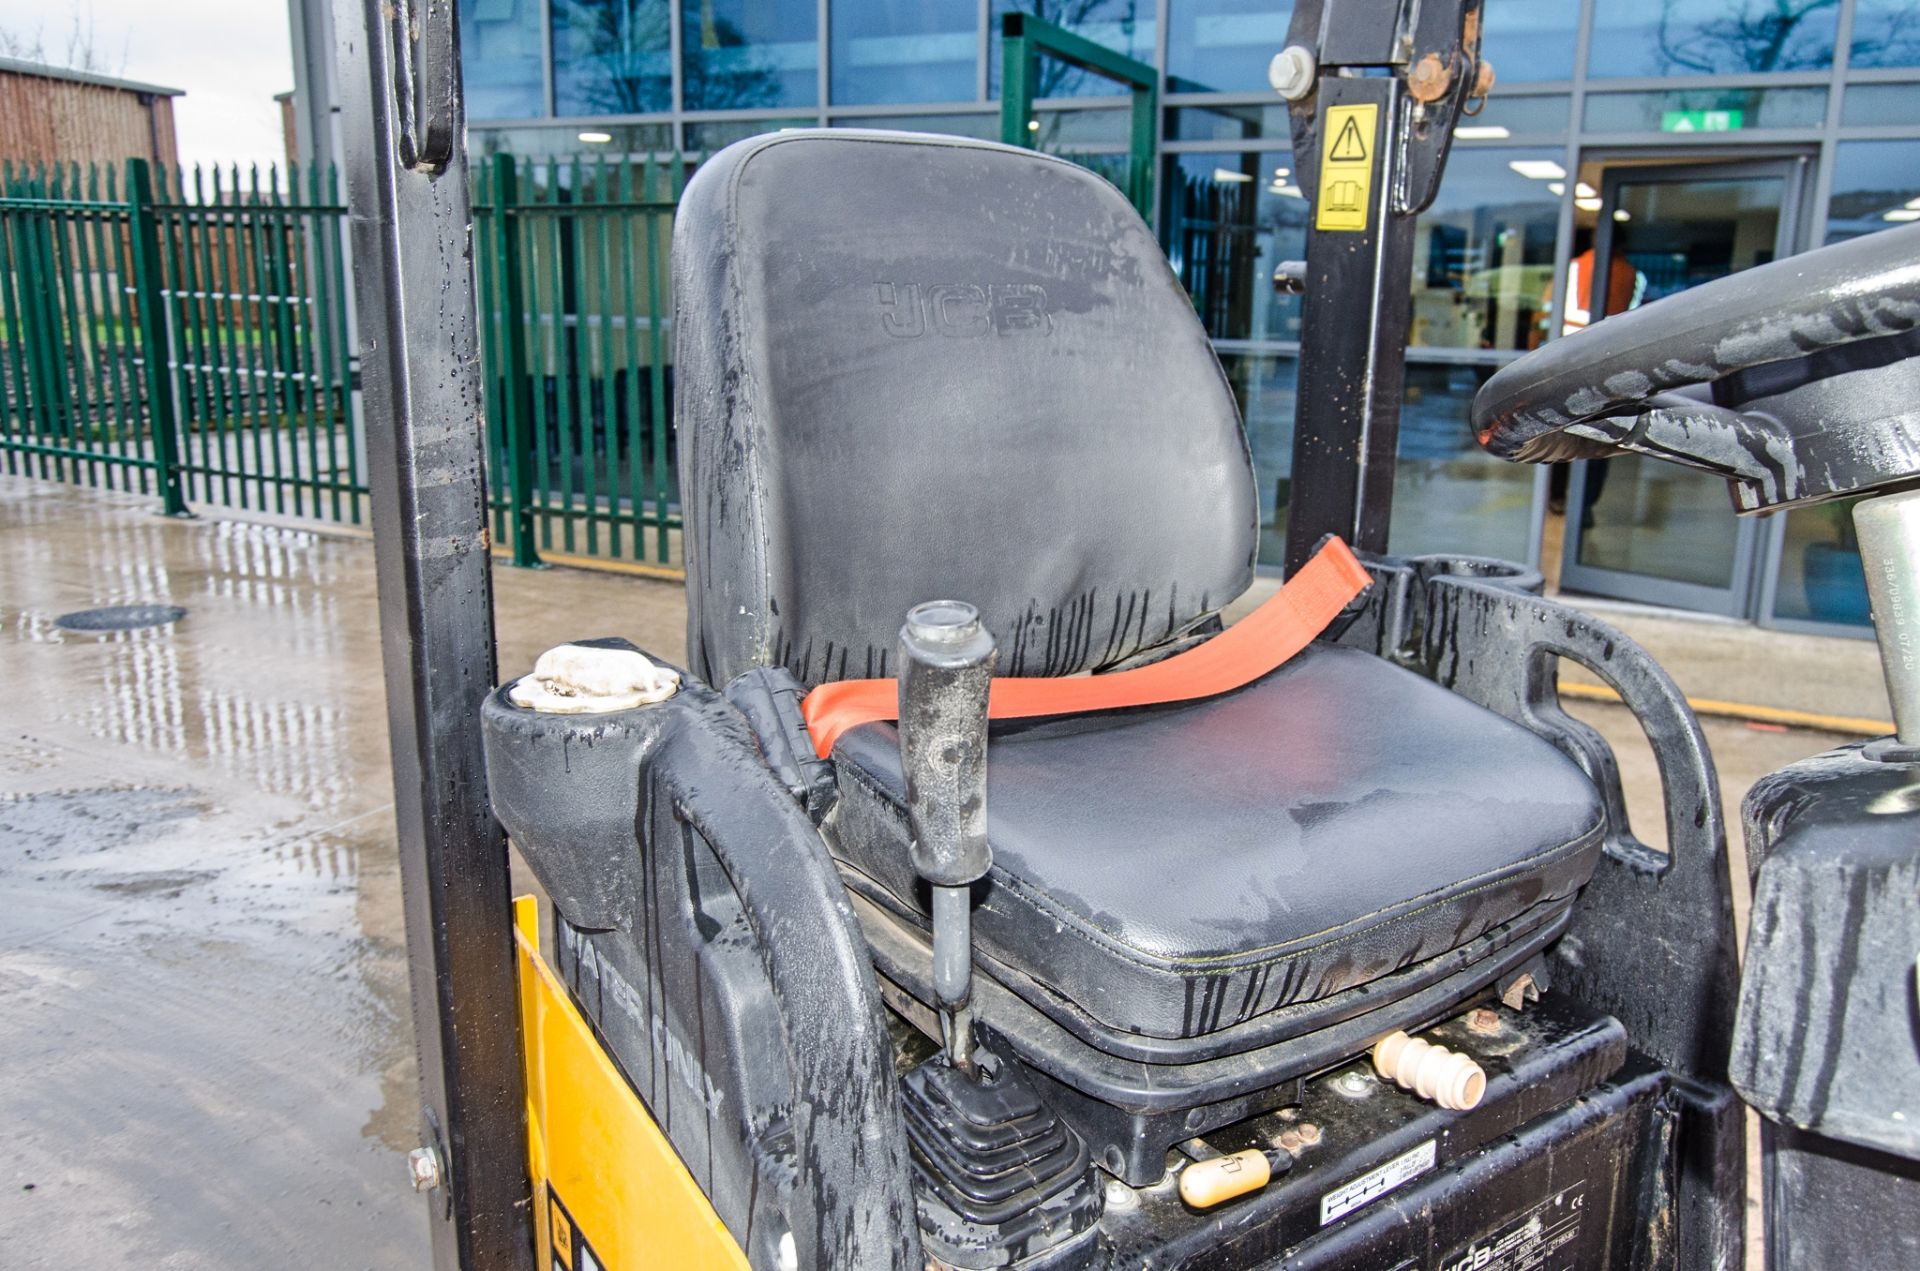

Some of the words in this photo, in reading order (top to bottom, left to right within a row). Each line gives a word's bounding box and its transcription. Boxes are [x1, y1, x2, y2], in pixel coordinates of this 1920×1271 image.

[873, 282, 1053, 338] JCB
[1899, 632, 1914, 671] 07/20
[560, 917, 645, 1032] WATER
[651, 1014, 725, 1120] ONLY
[1349, 1170, 1382, 1191] ADJUSTMENT
[1571, 1194, 1584, 1209] CE
